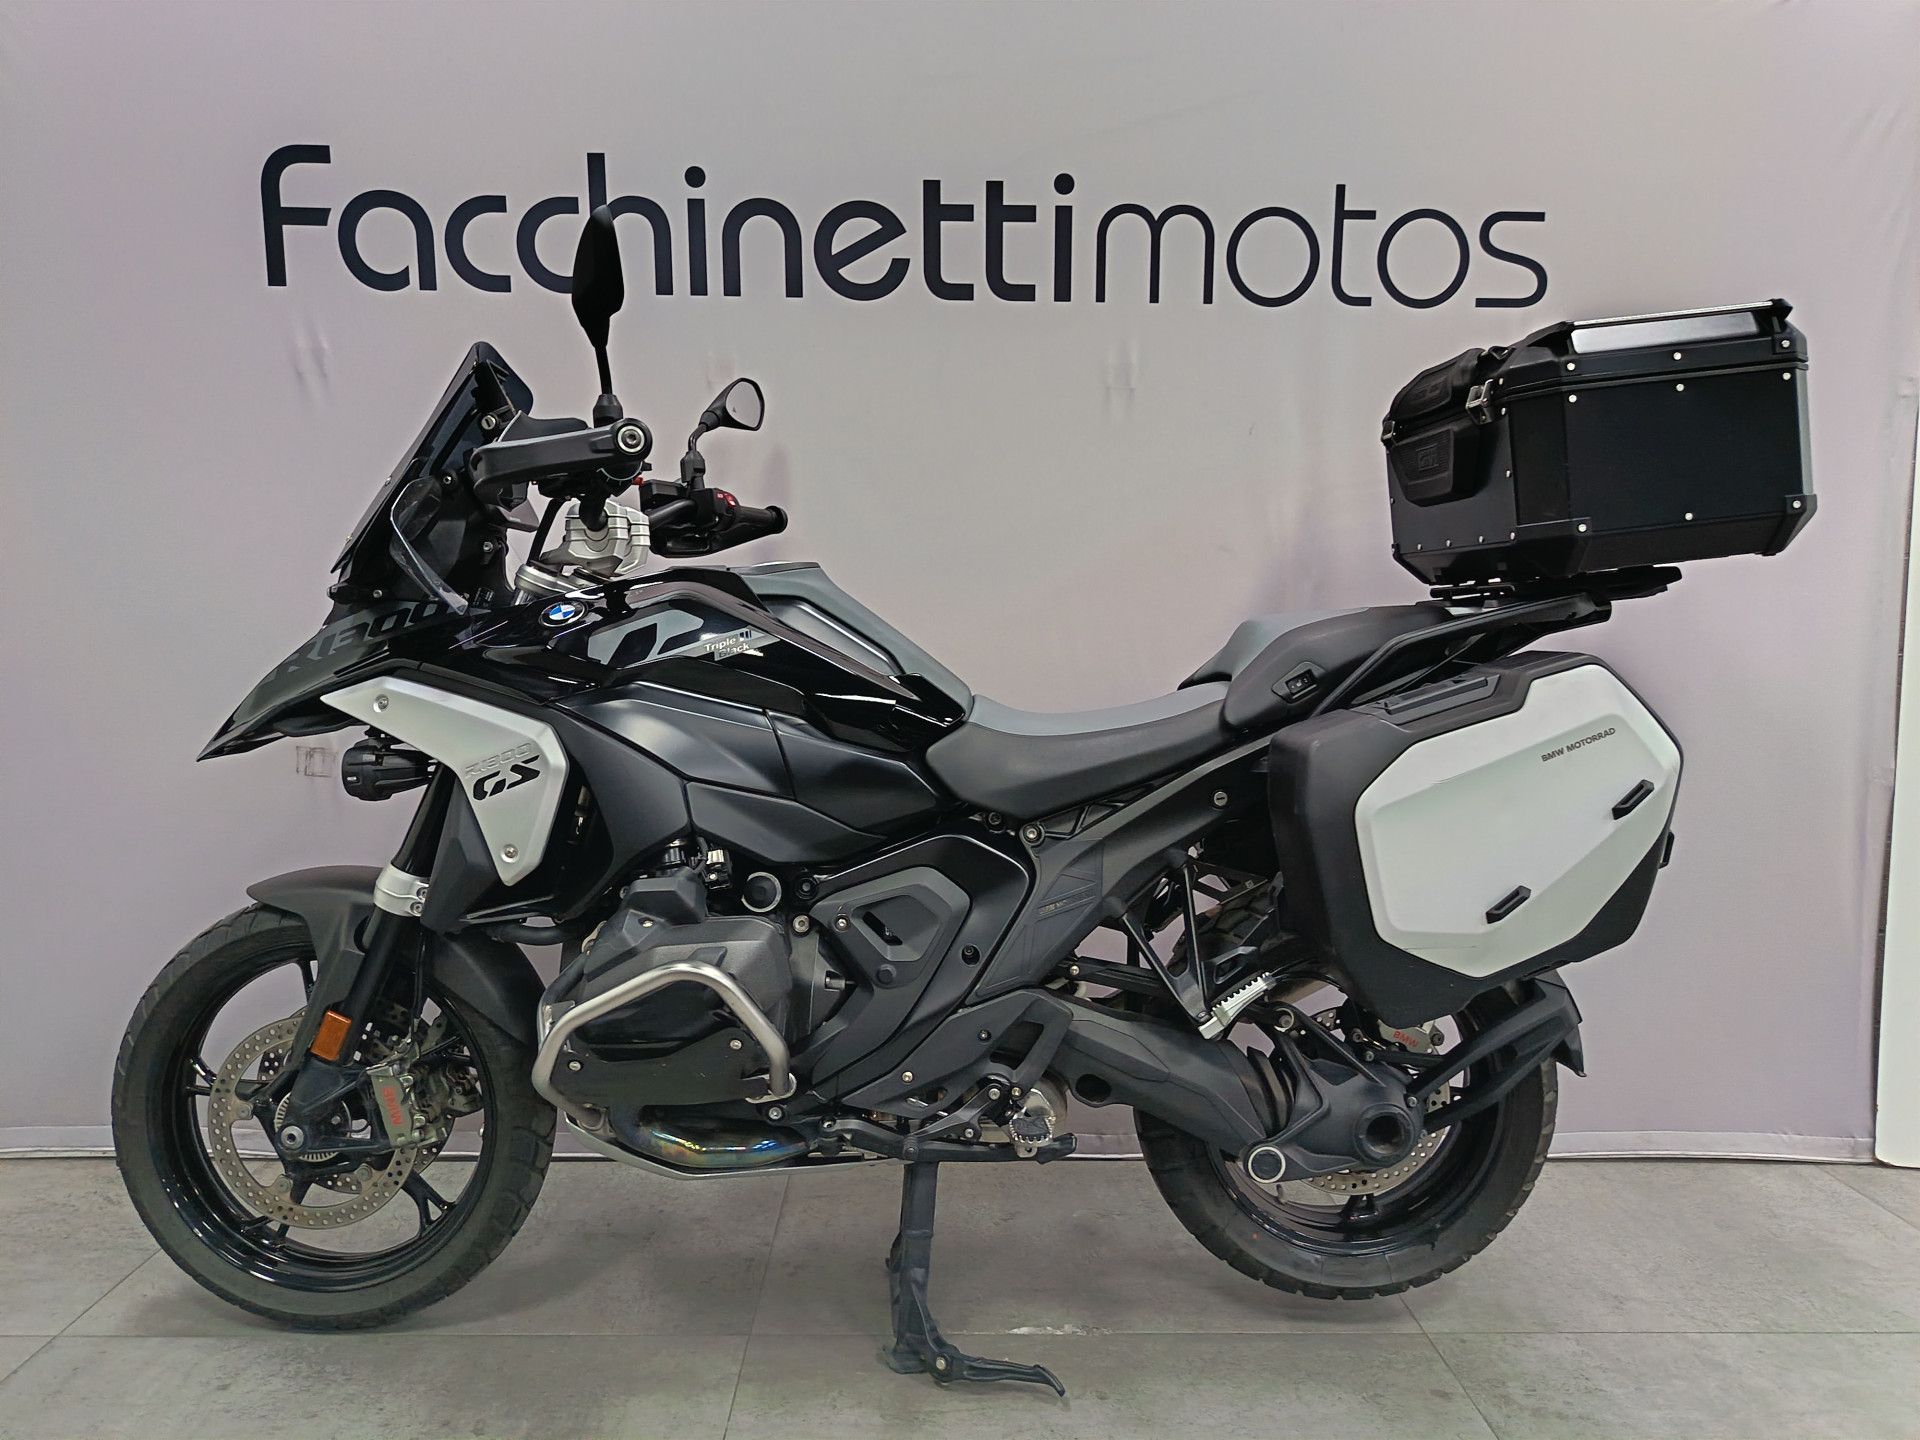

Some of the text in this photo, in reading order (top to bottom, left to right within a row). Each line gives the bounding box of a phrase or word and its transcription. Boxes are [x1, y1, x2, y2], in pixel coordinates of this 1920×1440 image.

[704, 637, 736, 651] Triple
[718, 643, 749, 657] Black
[1541, 727, 1616, 762] BMW MOTORRAD
[473, 753, 543, 801] GS
[1393, 1031, 1419, 1047] BMW
[382, 1086, 403, 1125] BMW
